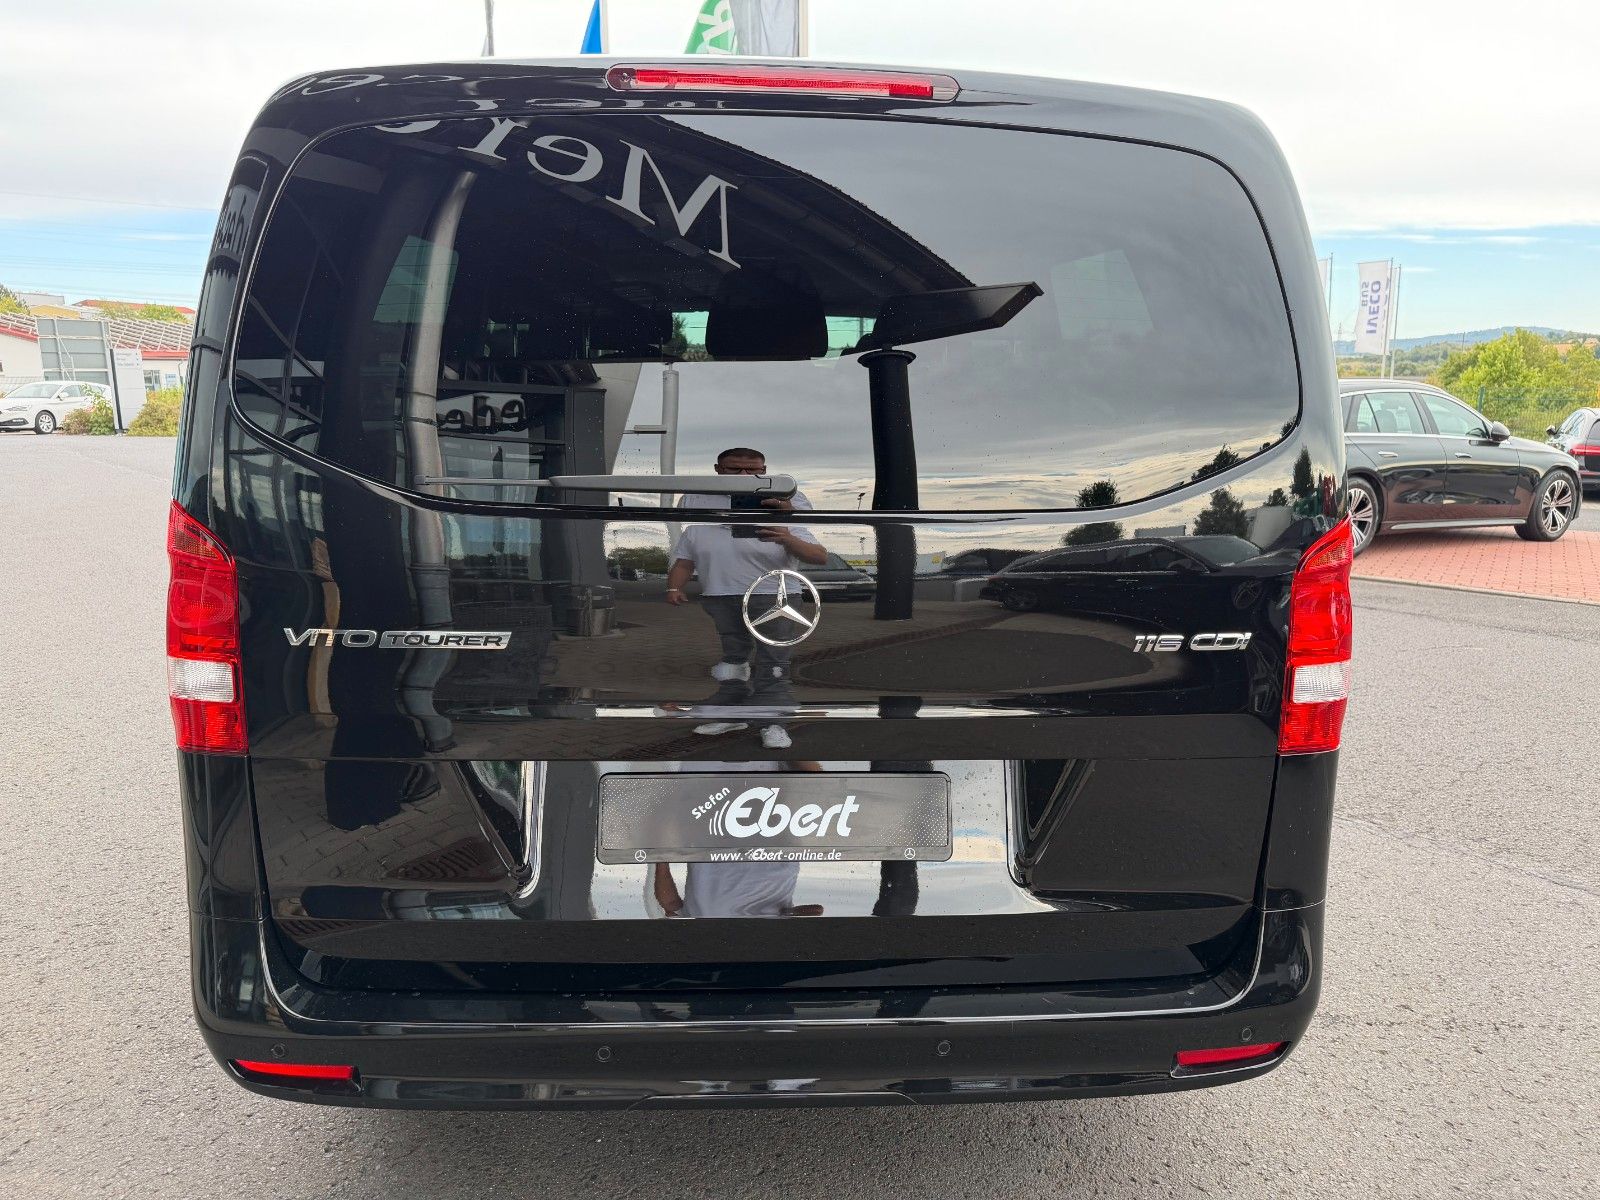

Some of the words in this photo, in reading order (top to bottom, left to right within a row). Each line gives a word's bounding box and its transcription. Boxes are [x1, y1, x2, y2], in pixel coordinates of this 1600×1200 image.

[283, 627, 377, 648] VITO
[386, 633, 504, 647] TOURER
[1190, 632, 1252, 651] CDI
[691, 786, 731, 820] Stefan
[724, 786, 860, 838] Ebert
